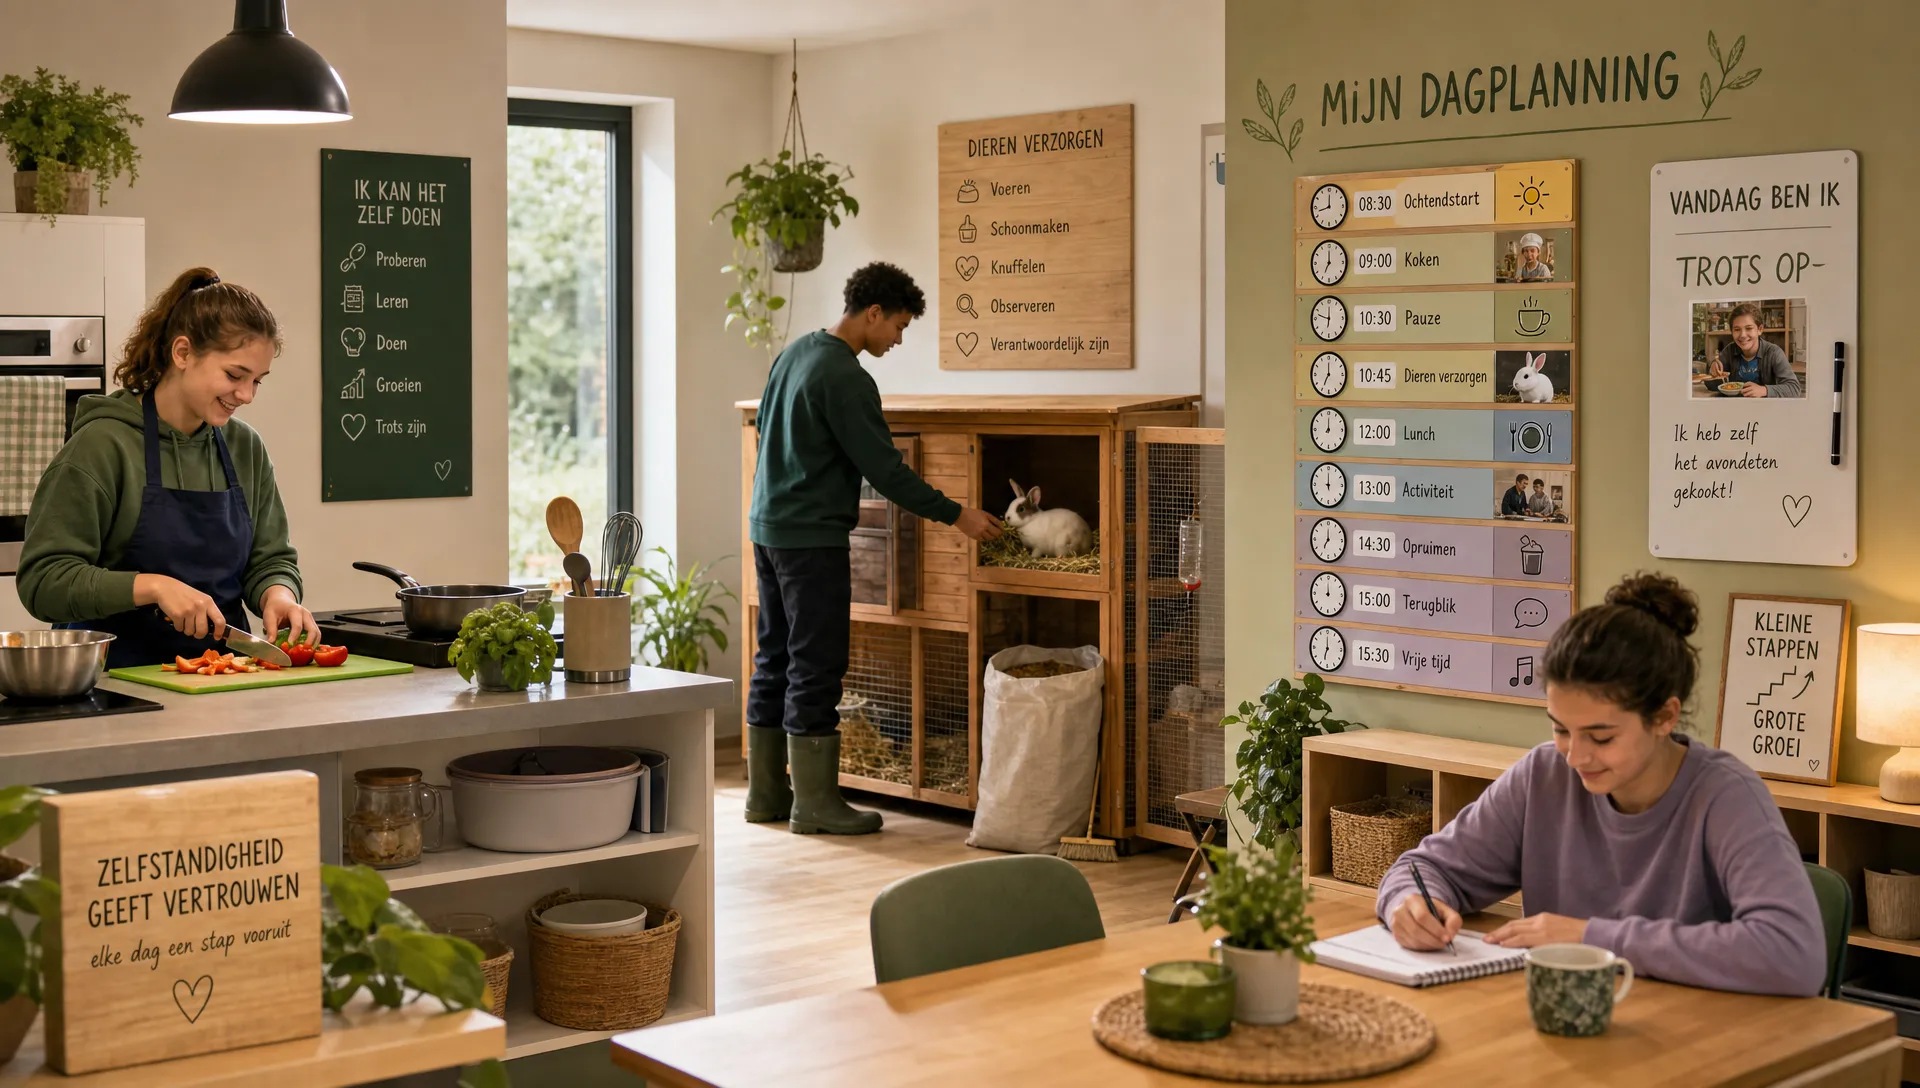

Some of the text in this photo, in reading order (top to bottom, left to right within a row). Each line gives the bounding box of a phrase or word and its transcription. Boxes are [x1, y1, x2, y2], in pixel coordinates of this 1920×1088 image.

[1420, 50, 1680, 119] DAGPLANNING
[968, 127, 1104, 158] DIEREN VERZORGEN
[355, 179, 447, 203] IK KAN HET
[990, 181, 1031, 197] Voeren
[1669, 181, 1841, 216] VANDAAG BEN IK
[1358, 191, 1480, 212] 08:30 Ochtendstart
[357, 205, 441, 227] ZELF DOEN
[990, 218, 1070, 237] Schoonmaken
[376, 250, 427, 268] Proberen
[991, 258, 1046, 275] Knuffelen
[1358, 251, 1440, 269] 09:00 Koken
[1675, 254, 1762, 288] TROTS
[376, 292, 409, 309] Leren
[990, 298, 1055, 314] Observeren
[1358, 309, 1441, 326] 10:30 Pauze
[376, 334, 407, 351] Doen
[990, 335, 1110, 356] Verantwoordelijk zijn
[376, 376, 422, 393] Groeien
[1359, 367, 1487, 388] 10:45 Dieren verzorgen
[375, 418, 427, 439] Trots zijn
[1359, 424, 1436, 441] 12:00 Lunch
[1674, 421, 1759, 446] Ik heb zelf
[1674, 451, 1779, 471] het avondeten
[1359, 480, 1454, 499] 13:00 Activiteit
[1673, 480, 1733, 509] gekookt!
[1358, 535, 1456, 559] 14:30 Opruimen
[1359, 591, 1457, 617] 15:00 Terugblik
[1754, 611, 1813, 634] KLEINE
[1358, 645, 1451, 674] 15:30 Vrije tijd
[1745, 636, 1819, 661] STAPPEN
[1753, 709, 1807, 733] GROTE
[1752, 734, 1801, 758] GROEI
[97, 838, 284, 887] ZELFSTANDIGHEID
[87, 872, 299, 929] GEEFT VERTROUWEN
[90, 918, 292, 971] elke dag een stap vooruit
